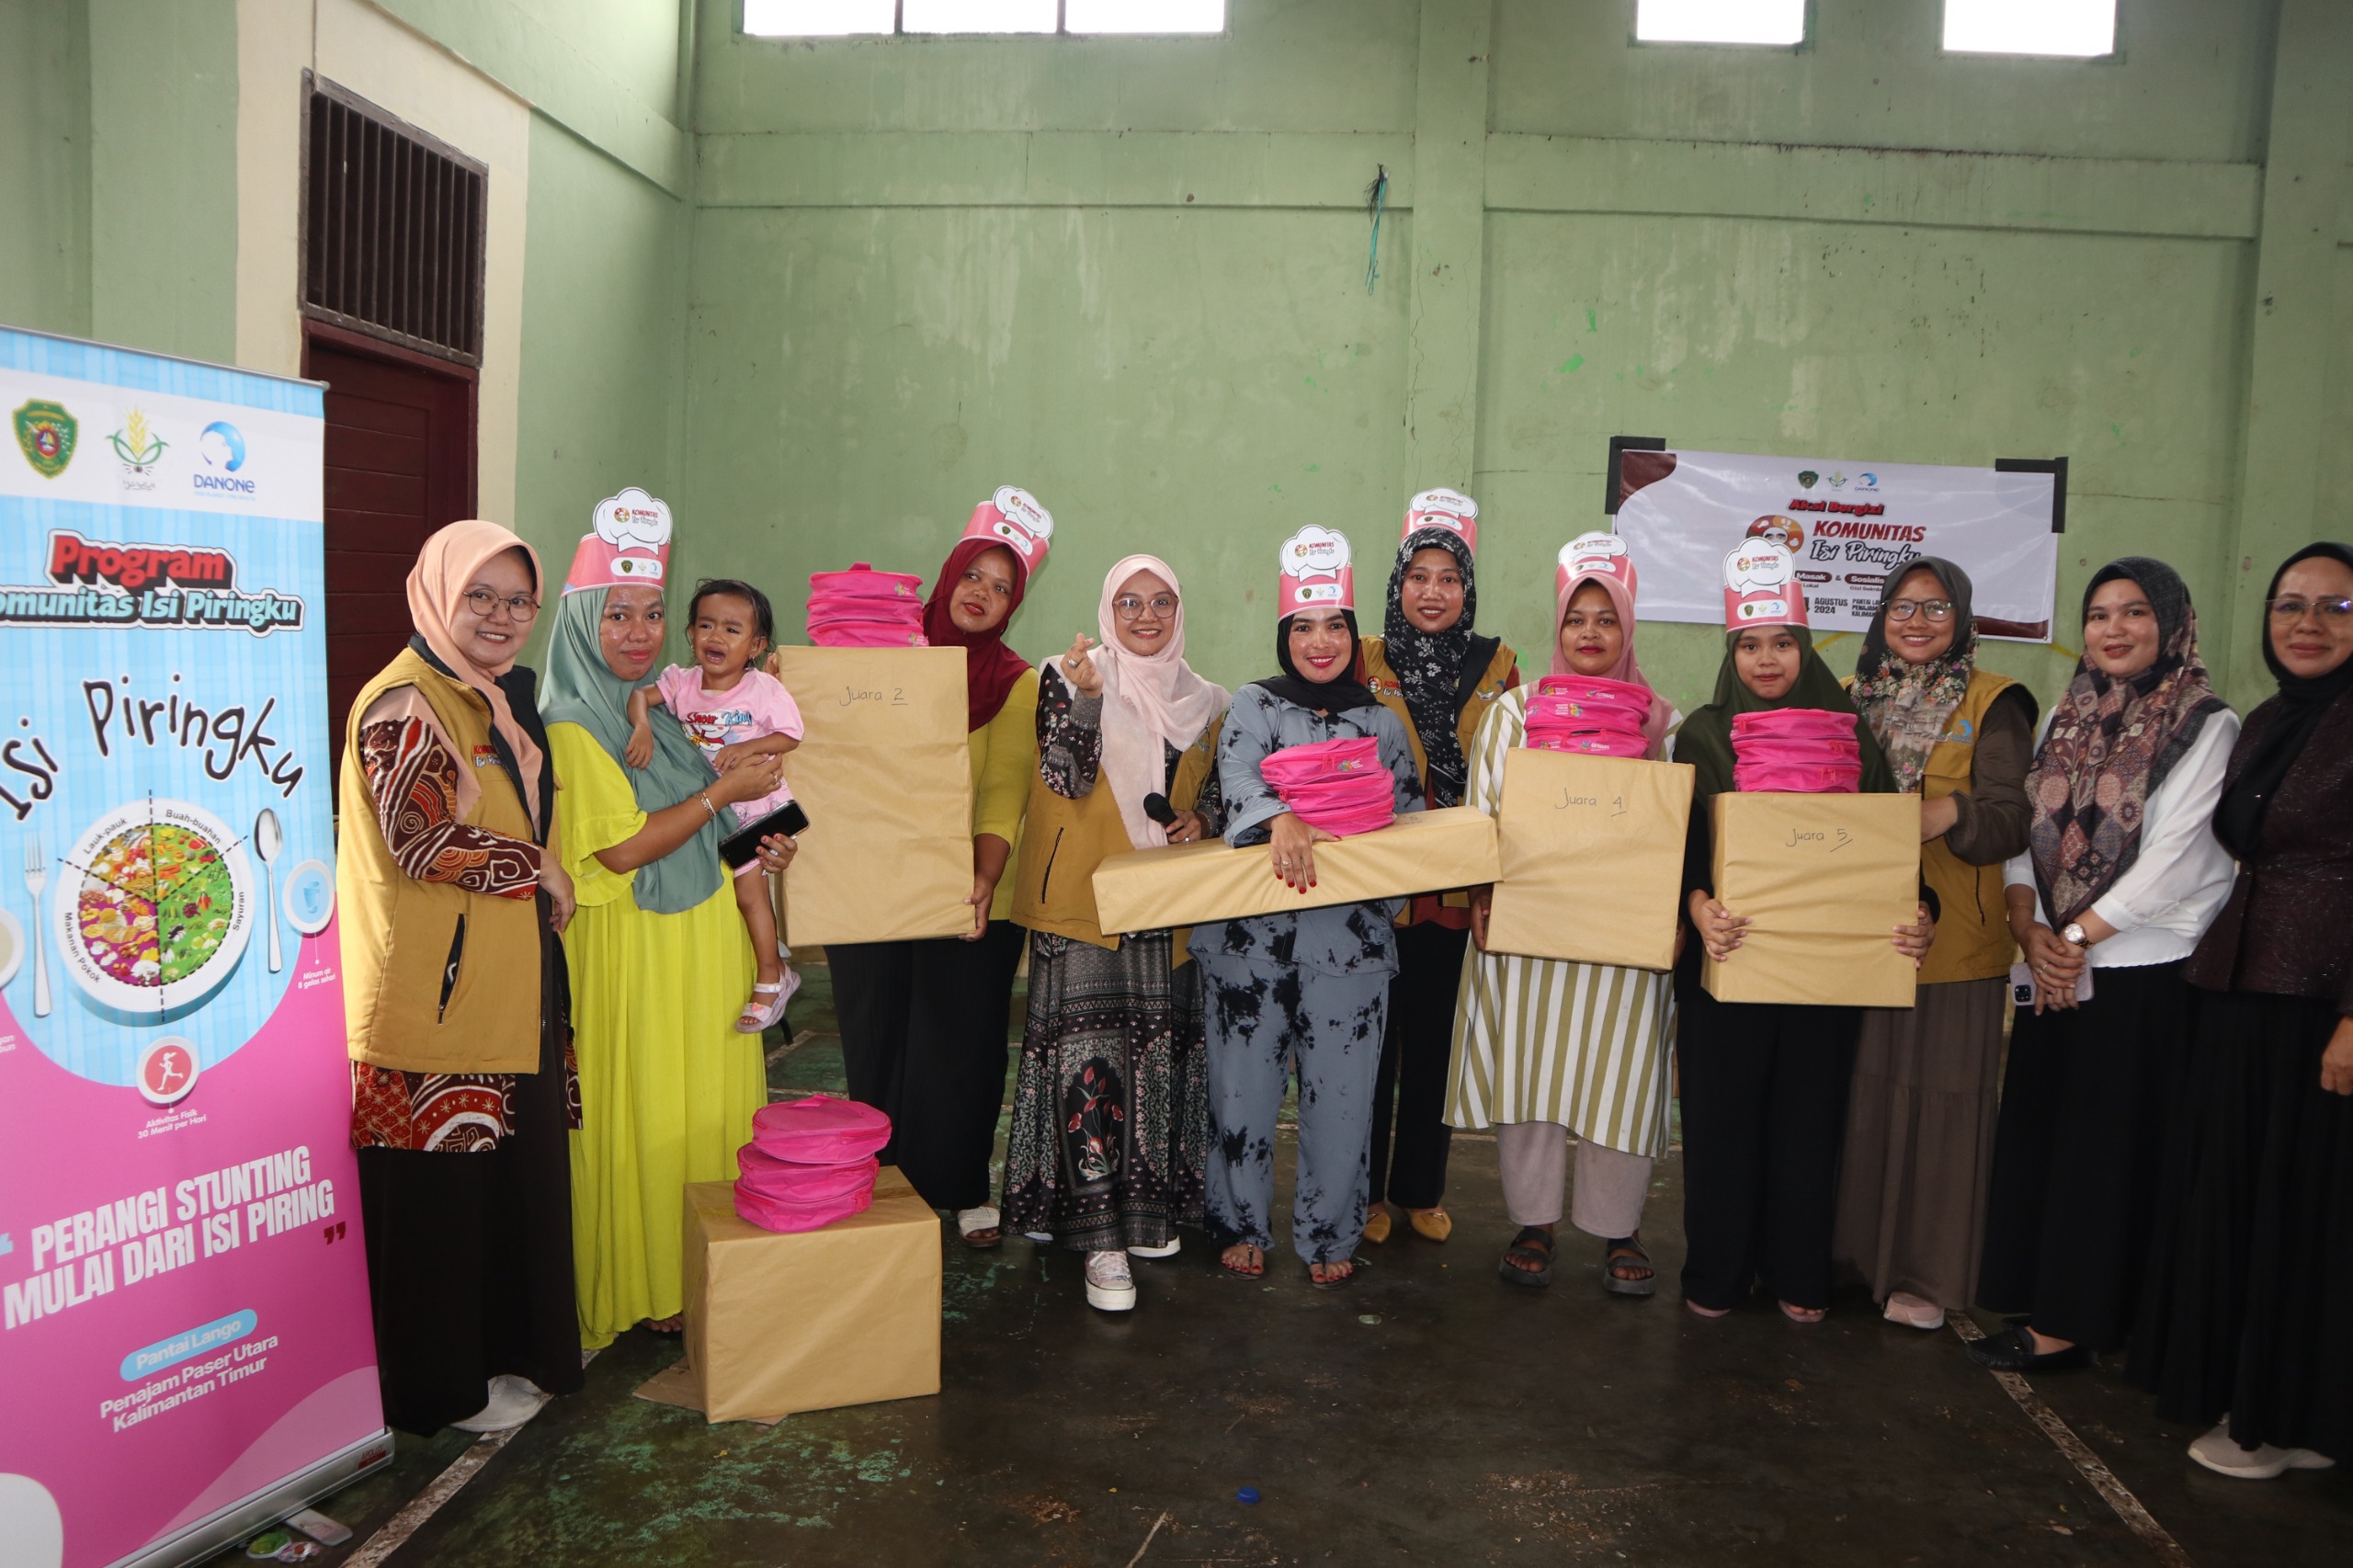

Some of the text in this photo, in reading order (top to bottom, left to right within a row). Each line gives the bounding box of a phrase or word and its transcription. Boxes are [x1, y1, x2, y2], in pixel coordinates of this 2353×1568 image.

[193, 473, 256, 494] DANONE
[1813, 520, 1927, 543] KOMUNITAS
[50, 534, 228, 588] Program
[1809, 540, 1841, 561] Isi
[1796, 572, 1826, 581] Masak
[1850, 575, 1885, 584] Sosialis
[0, 585, 298, 628] munitas Isi Piringku
[1813, 597, 1848, 607] AGUSTUS
[1813, 606, 1836, 614] 2024
[839, 686, 904, 706] Juara 2
[721, 710, 752, 726] King
[83, 674, 303, 798] Piringku
[1555, 788, 1597, 809] Juara
[84, 817, 128, 855] Lauk-pauk
[166, 809, 221, 845] Buah-buahan
[1786, 828, 1824, 846] Juara
[232, 892, 244, 931] Sayuran
[64, 912, 101, 983] Makanan Pokok
[138, 1114, 206, 1139] 30 Menit per Hari
[146, 1108, 198, 1129] Aktivitas Fisik
[31, 1145, 312, 1272] PERANGI STUNTING
[3, 1179, 335, 1330] MULAI DARI ISI PIRING
[135, 1319, 242, 1370] Pantai Lango
[99, 1335, 278, 1418] Penajam Paser Utara
[112, 1357, 267, 1433] Kalimantan Timur
